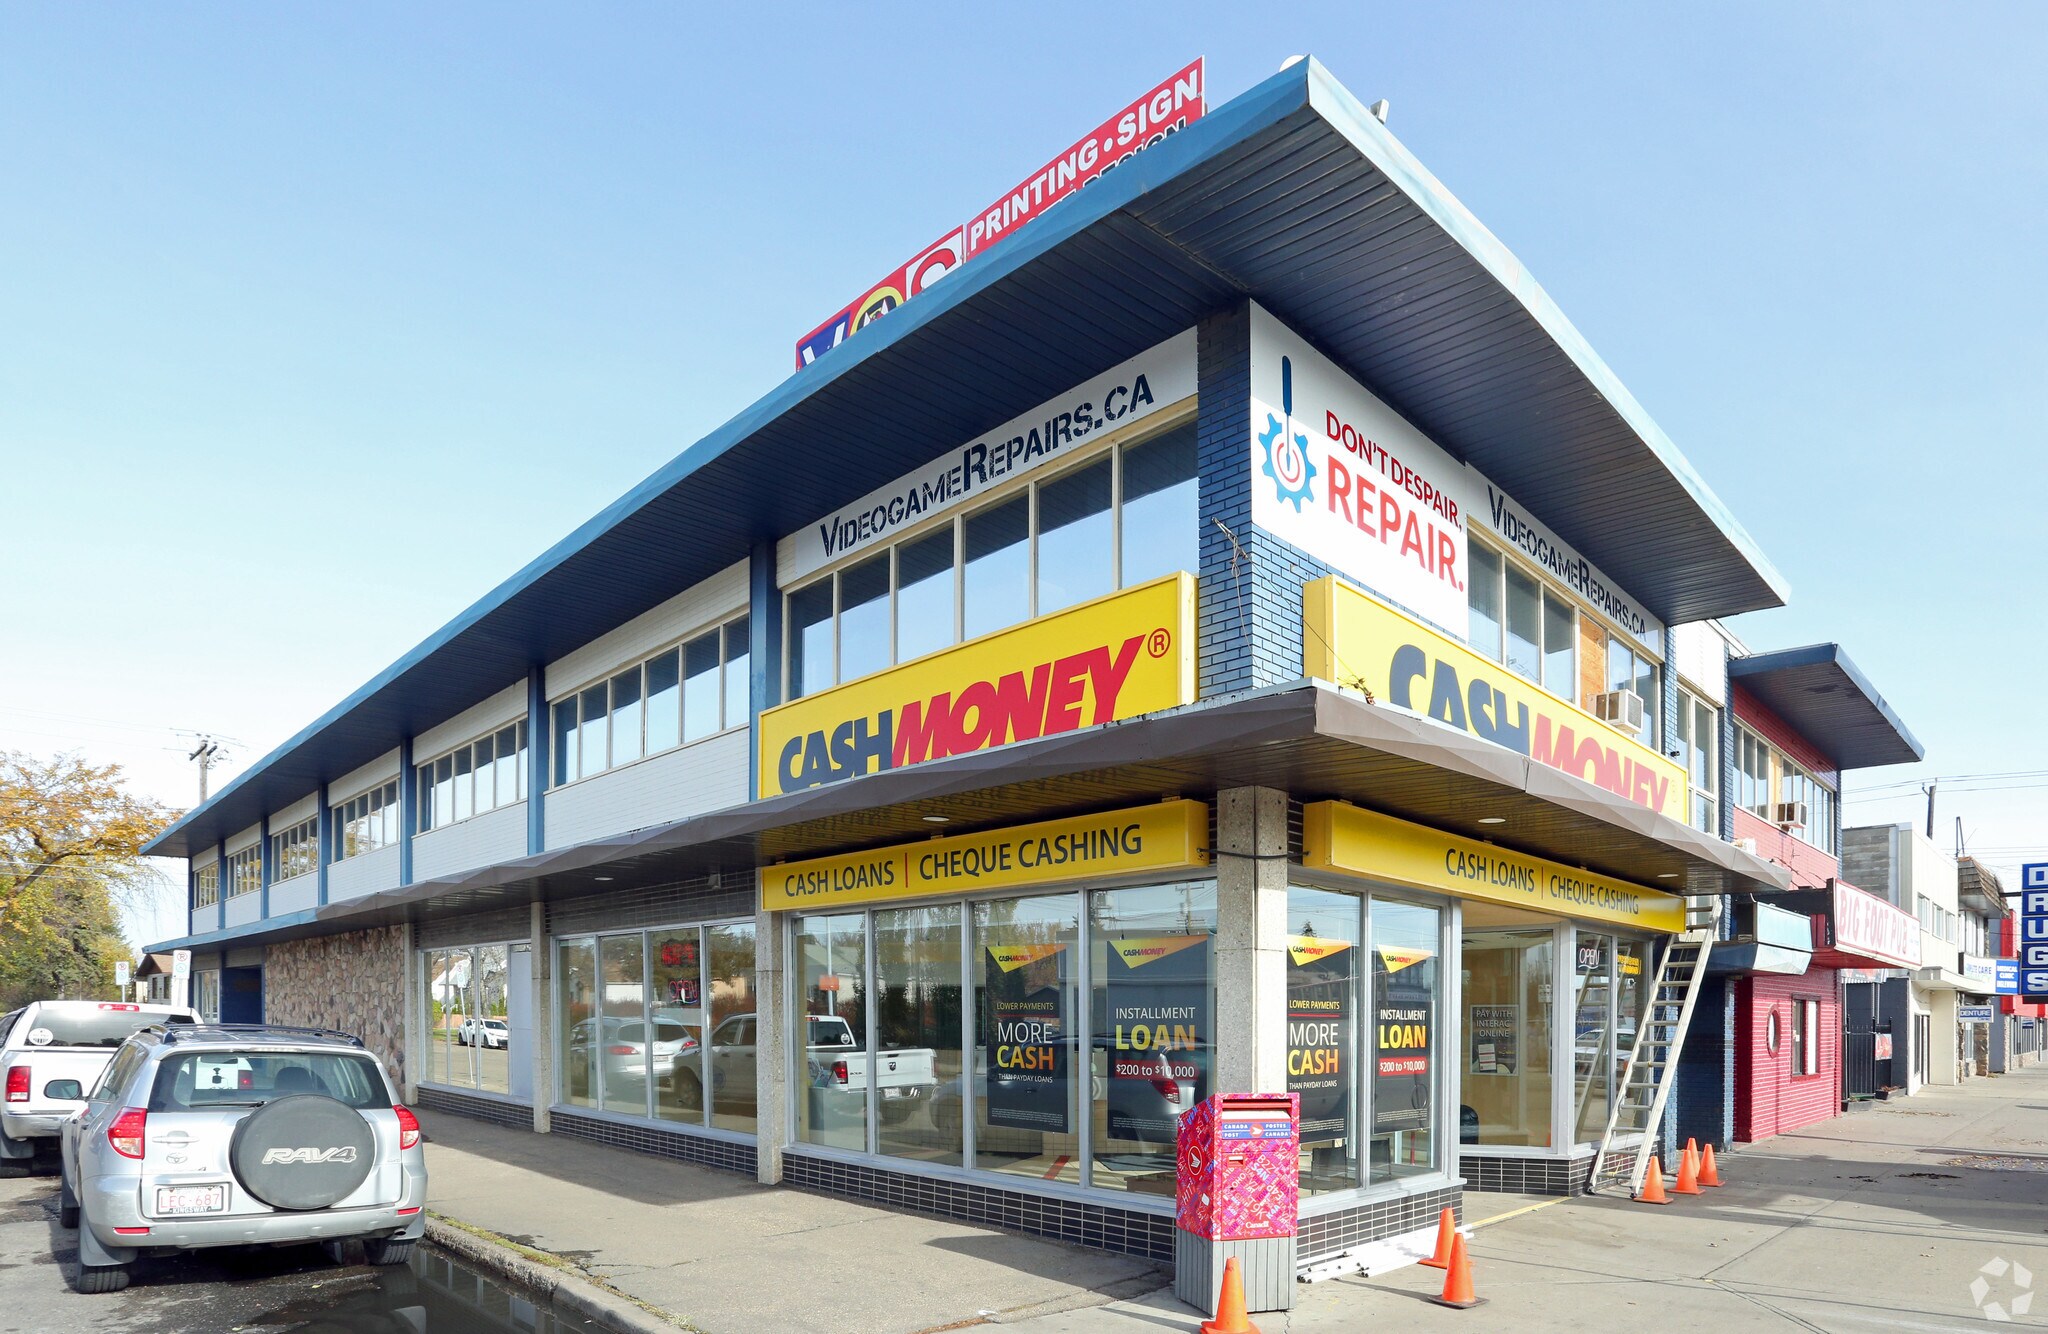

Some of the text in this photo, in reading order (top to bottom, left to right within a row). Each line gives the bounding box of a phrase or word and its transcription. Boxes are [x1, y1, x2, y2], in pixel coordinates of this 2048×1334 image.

[970, 138, 1098, 252] PRINTING
[1117, 67, 1198, 147] SIGN
[1325, 409, 1463, 533] DON'T DESPAIR,
[1326, 454, 1465, 593] REPAIR.
[785, 823, 1143, 897] CASH LOANS CHEQUE CASHING
[1444, 848, 1640, 916] CASH LOANS CHEQUE CASHING
[1838, 889, 1861, 942] BIG
[1863, 900, 1889, 949] FOOT
[1890, 912, 1908, 956] PUB
[1579, 947, 1601, 965] OPEN
[996, 1002, 1054, 1011] LOWER PAYMENTS
[1115, 1006, 1196, 1020] INSTALLMENT
[1289, 999, 1340, 1011] LOWER PAYMENTS
[1476, 1009, 1513, 1018] PAY WITH
[1960, 1009, 1991, 1017] DENTURE
[1380, 1009, 1427, 1022] INSTALLMENT
[1476, 1019, 1511, 1028] INTERAC
[997, 1022, 1053, 1044] MORE
[1115, 1024, 1196, 1051] LOAN
[1289, 1022, 1339, 1047] MORE
[1379, 1024, 1427, 1050] LOAN
[1479, 1029, 1510, 1038] ONLINE
[996, 1045, 1055, 1071] CASH
[1288, 1049, 1339, 1076] CASH
[1380, 1060, 1426, 1073] $200 to $10,000
[1013, 1074, 1034, 1083] PAYDAY
[1034, 1075, 1053, 1084] LOANS
[1116, 1064, 1195, 1079] $200 to $10,000
[1289, 1079, 1338, 1090] THAN PAYDAY LOANS
[262, 1146, 357, 1165] RAV4
[172, 1206, 208, 1215] KINGSWAY
